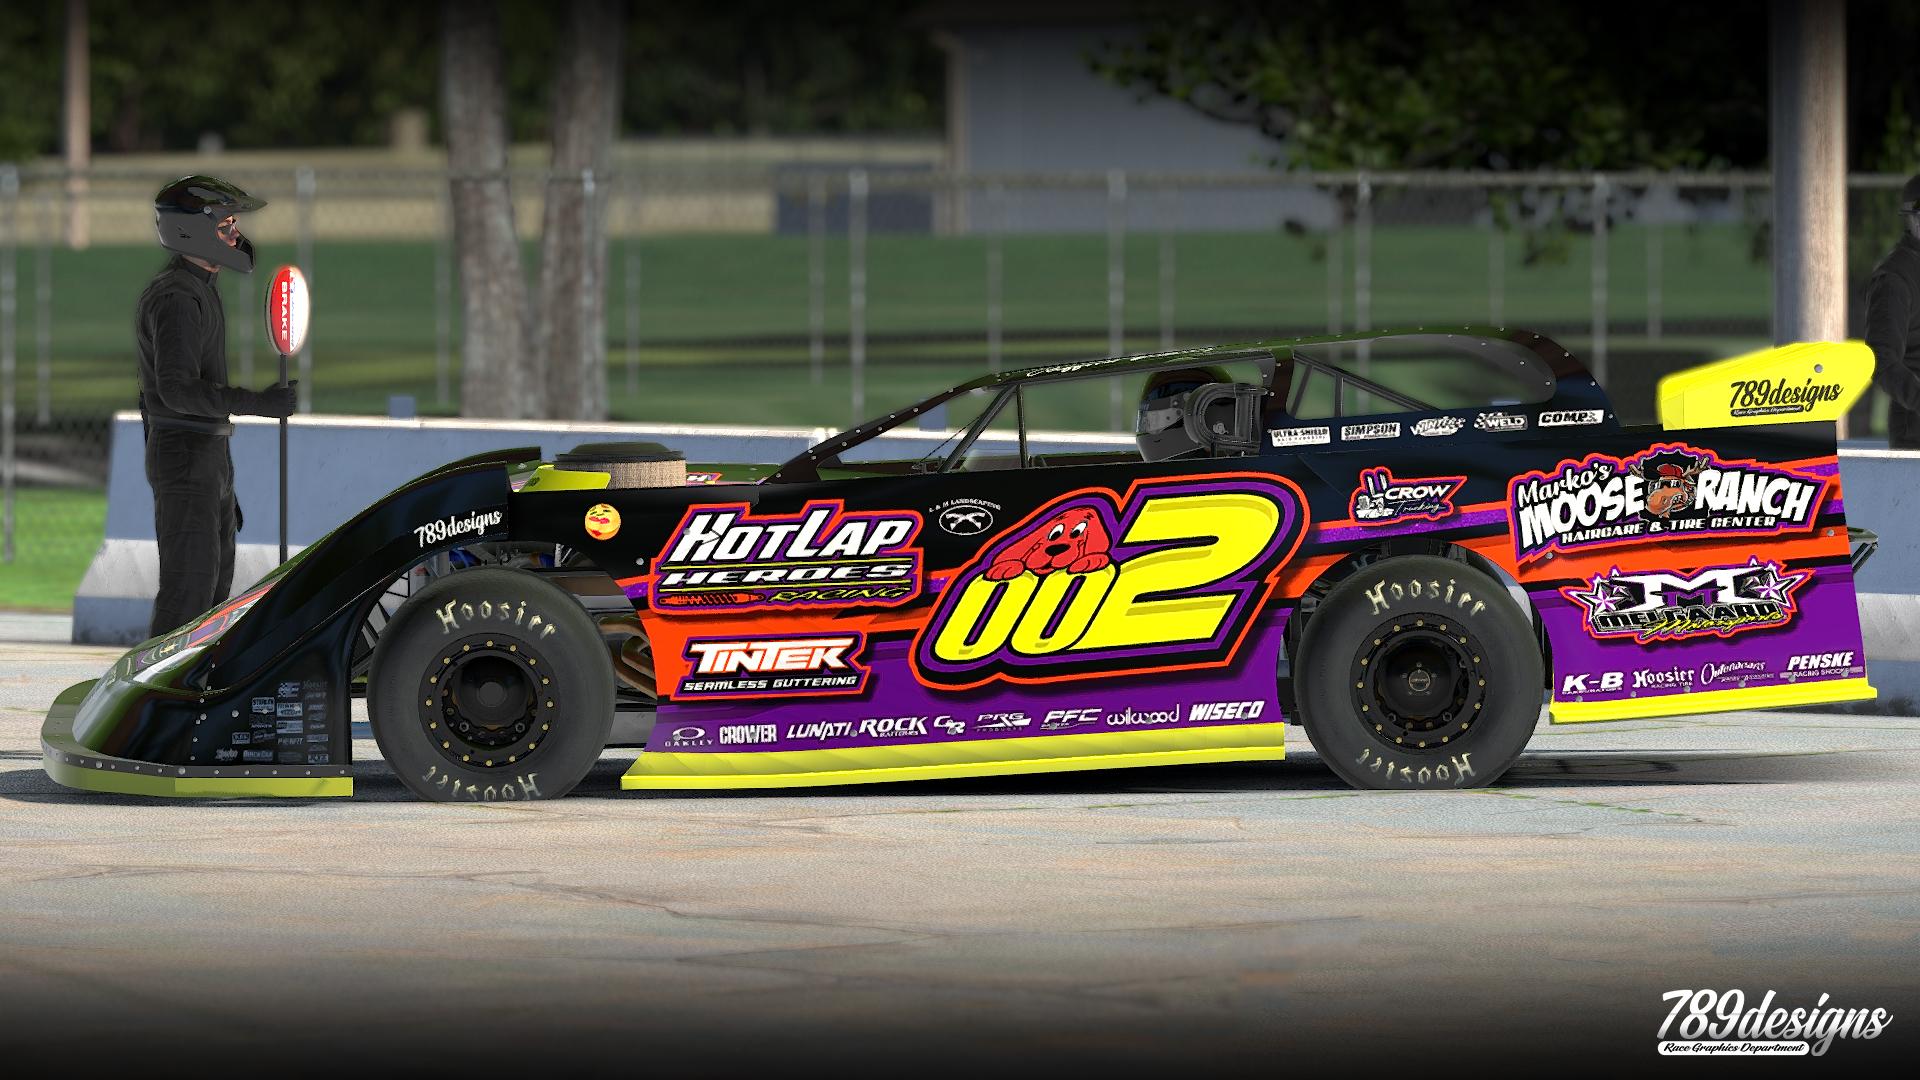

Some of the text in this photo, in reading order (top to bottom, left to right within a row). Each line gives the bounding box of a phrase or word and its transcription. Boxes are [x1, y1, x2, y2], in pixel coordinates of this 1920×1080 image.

[1730, 378, 1844, 412] 789designs
[1486, 416, 1525, 427] WELD
[1541, 412, 1588, 424] COMP
[1344, 423, 1398, 436] SIMPSON
[1384, 484, 1452, 500] CROW
[1517, 462, 1613, 508] Marko's
[950, 498, 1001, 511] LANDSCAPING
[1518, 469, 1815, 549] MOOSE RANCH
[413, 510, 503, 548] 789designs
[1562, 515, 1776, 545] HAIRCARE & TIRE CENTER
[660, 564, 913, 586] HEROES
[934, 493, 1280, 661] 002
[767, 587, 909, 602] RACING
[1365, 579, 1486, 616] Hoosier
[435, 599, 557, 640] Hoosier
[1787, 651, 1854, 670] PENSKE
[684, 676, 858, 691] SEAMLESS GUTTERING
[1563, 671, 1624, 693] K-B
[1632, 666, 1695, 688] Hoosier
[1044, 708, 1103, 723] PFC
[1106, 703, 1180, 726] wilwood
[1189, 700, 1265, 722] WISECO
[719, 724, 777, 745] CROWER
[786, 720, 853, 741] LUNATI
[858, 716, 929, 738] ROCK
[664, 739, 714, 748] OAKLEY
